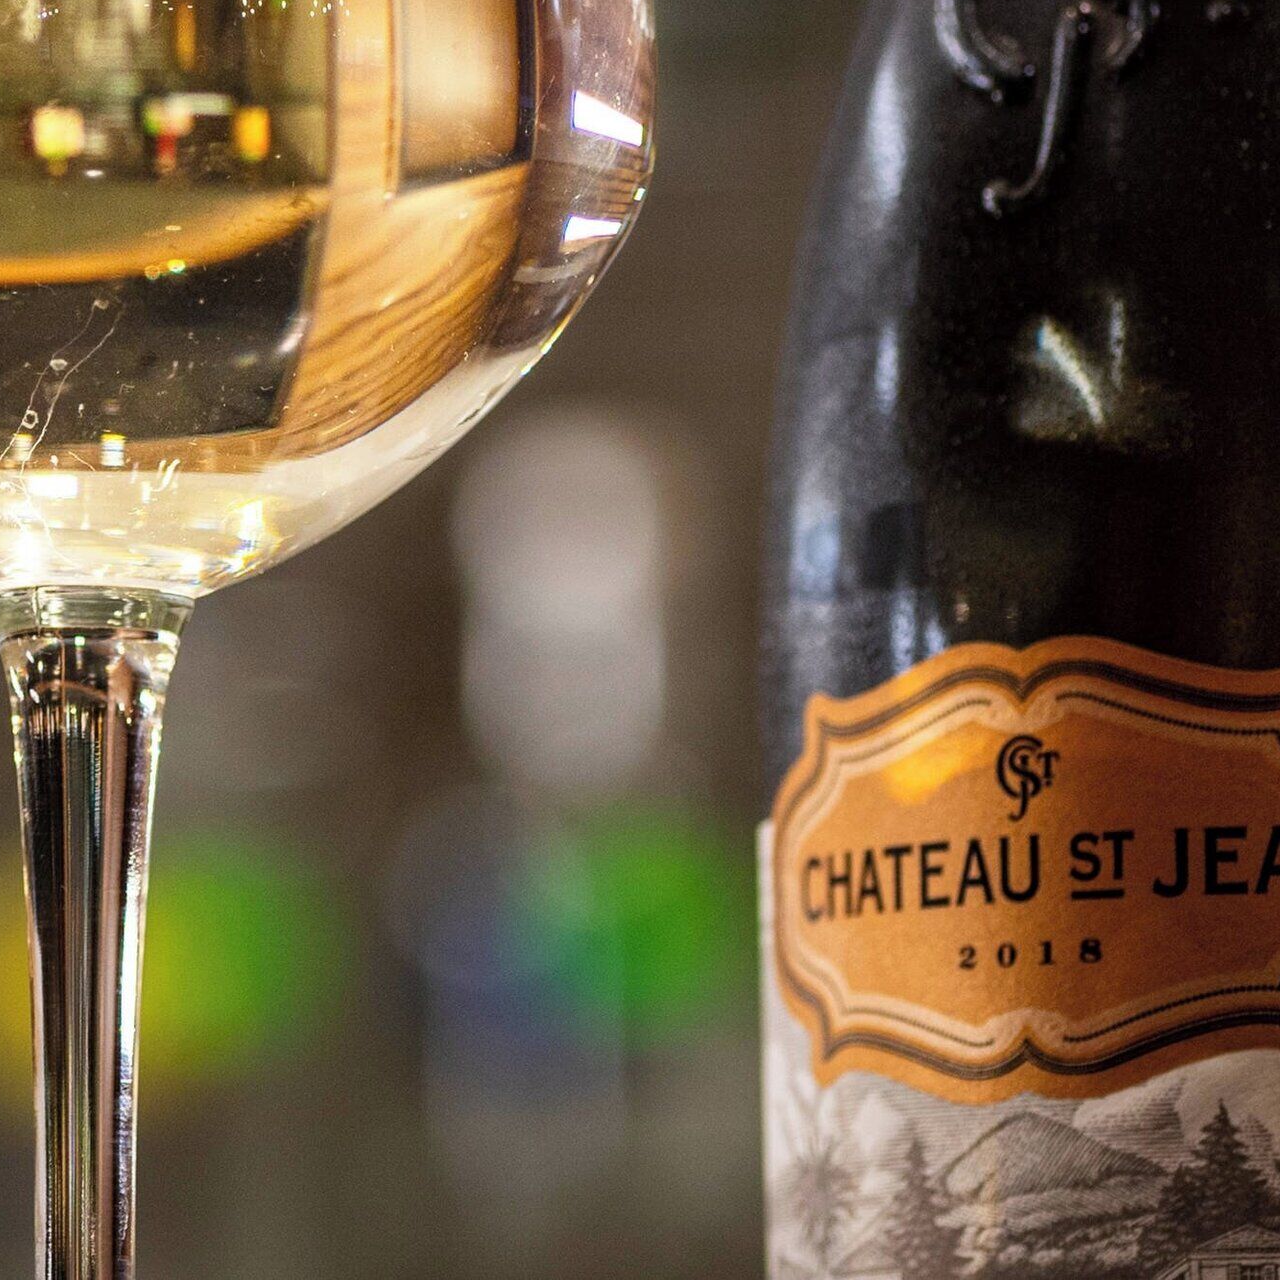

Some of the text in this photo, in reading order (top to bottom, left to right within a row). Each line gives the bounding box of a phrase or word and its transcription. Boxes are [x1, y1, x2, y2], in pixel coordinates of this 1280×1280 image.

[801, 833, 1040, 922] CHATEAU
[1069, 829, 1135, 884] ST
[958, 937, 1103, 970] 2018
